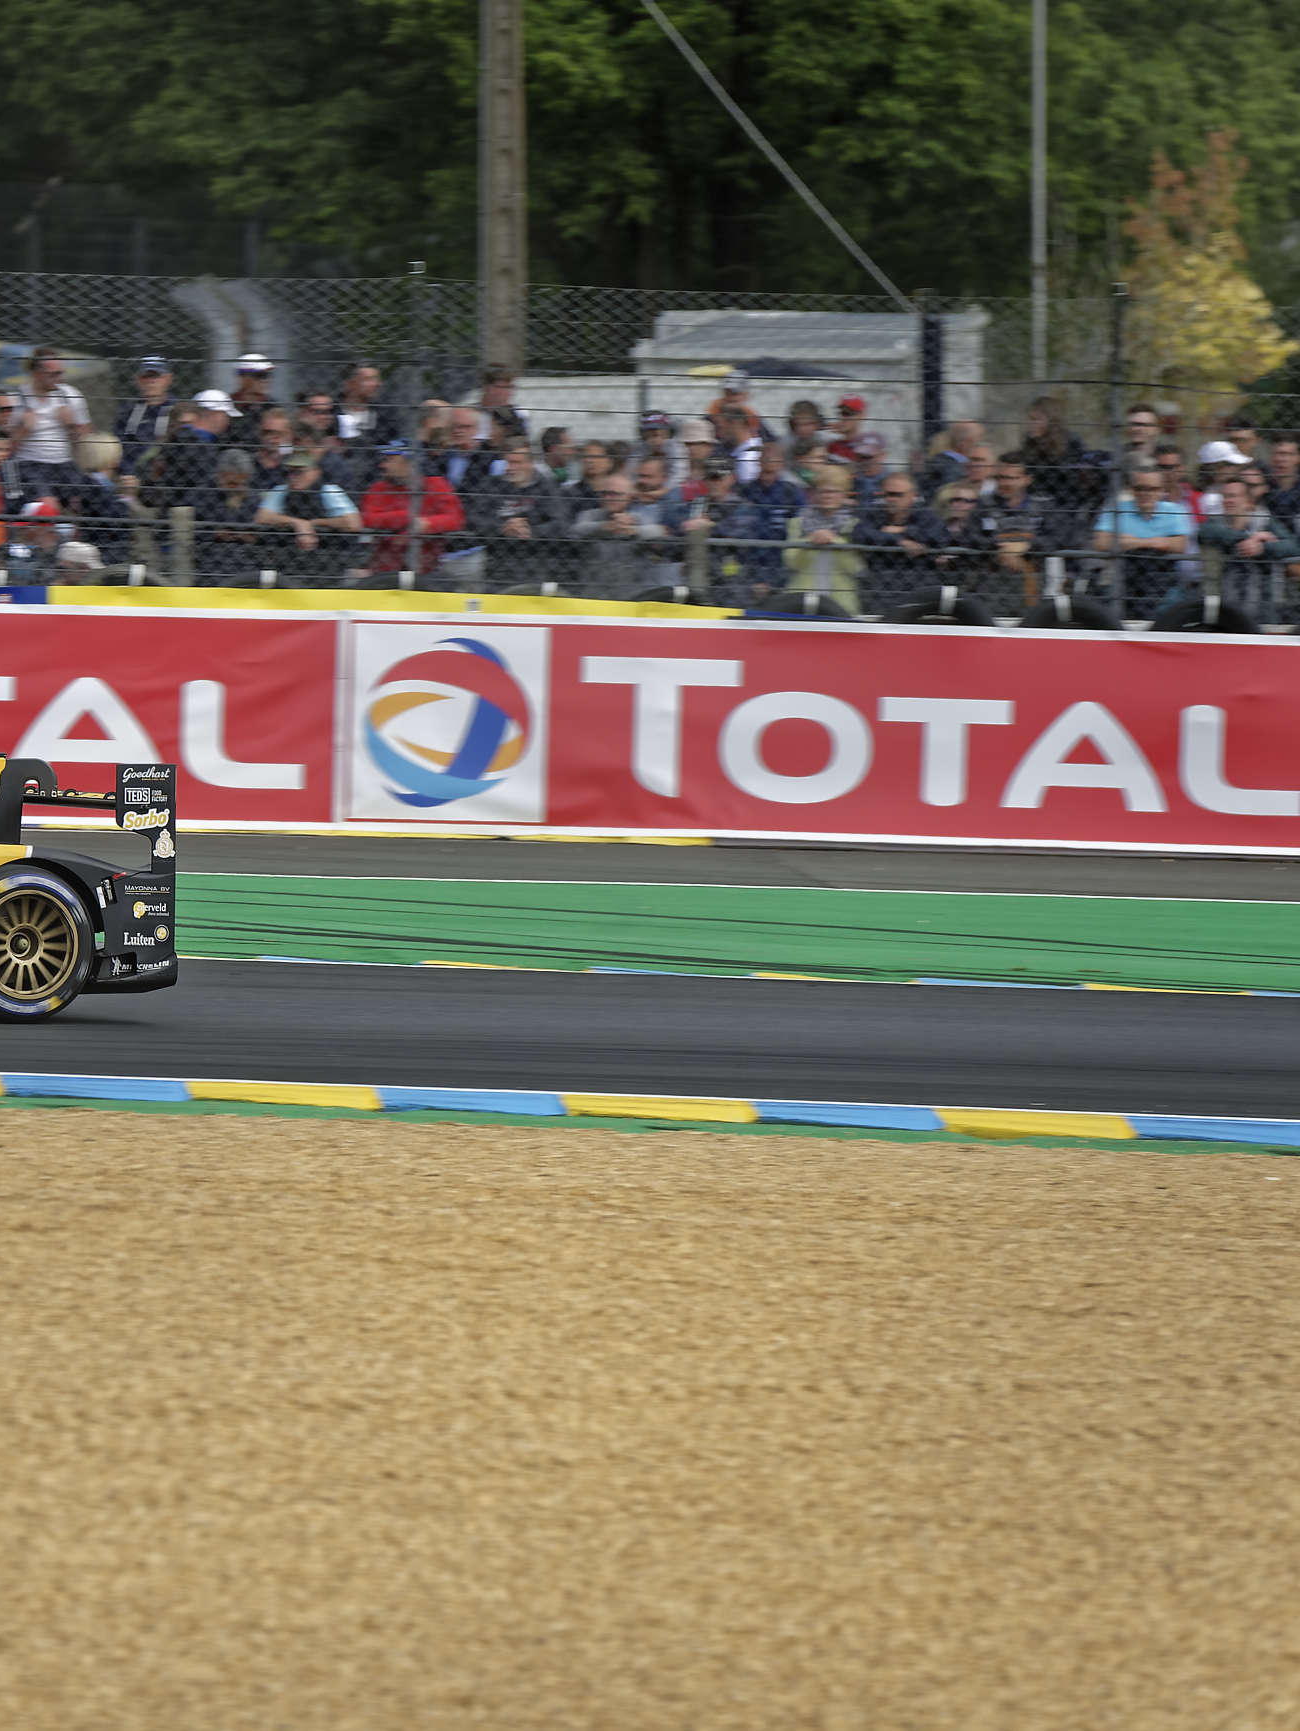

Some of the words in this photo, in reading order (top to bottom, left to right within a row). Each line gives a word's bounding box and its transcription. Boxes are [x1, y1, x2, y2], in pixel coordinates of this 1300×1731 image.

[580, 656, 1300, 817] TOTAL
[124, 809, 168, 829] Sorbo
[123, 932, 156, 946] Luiten
